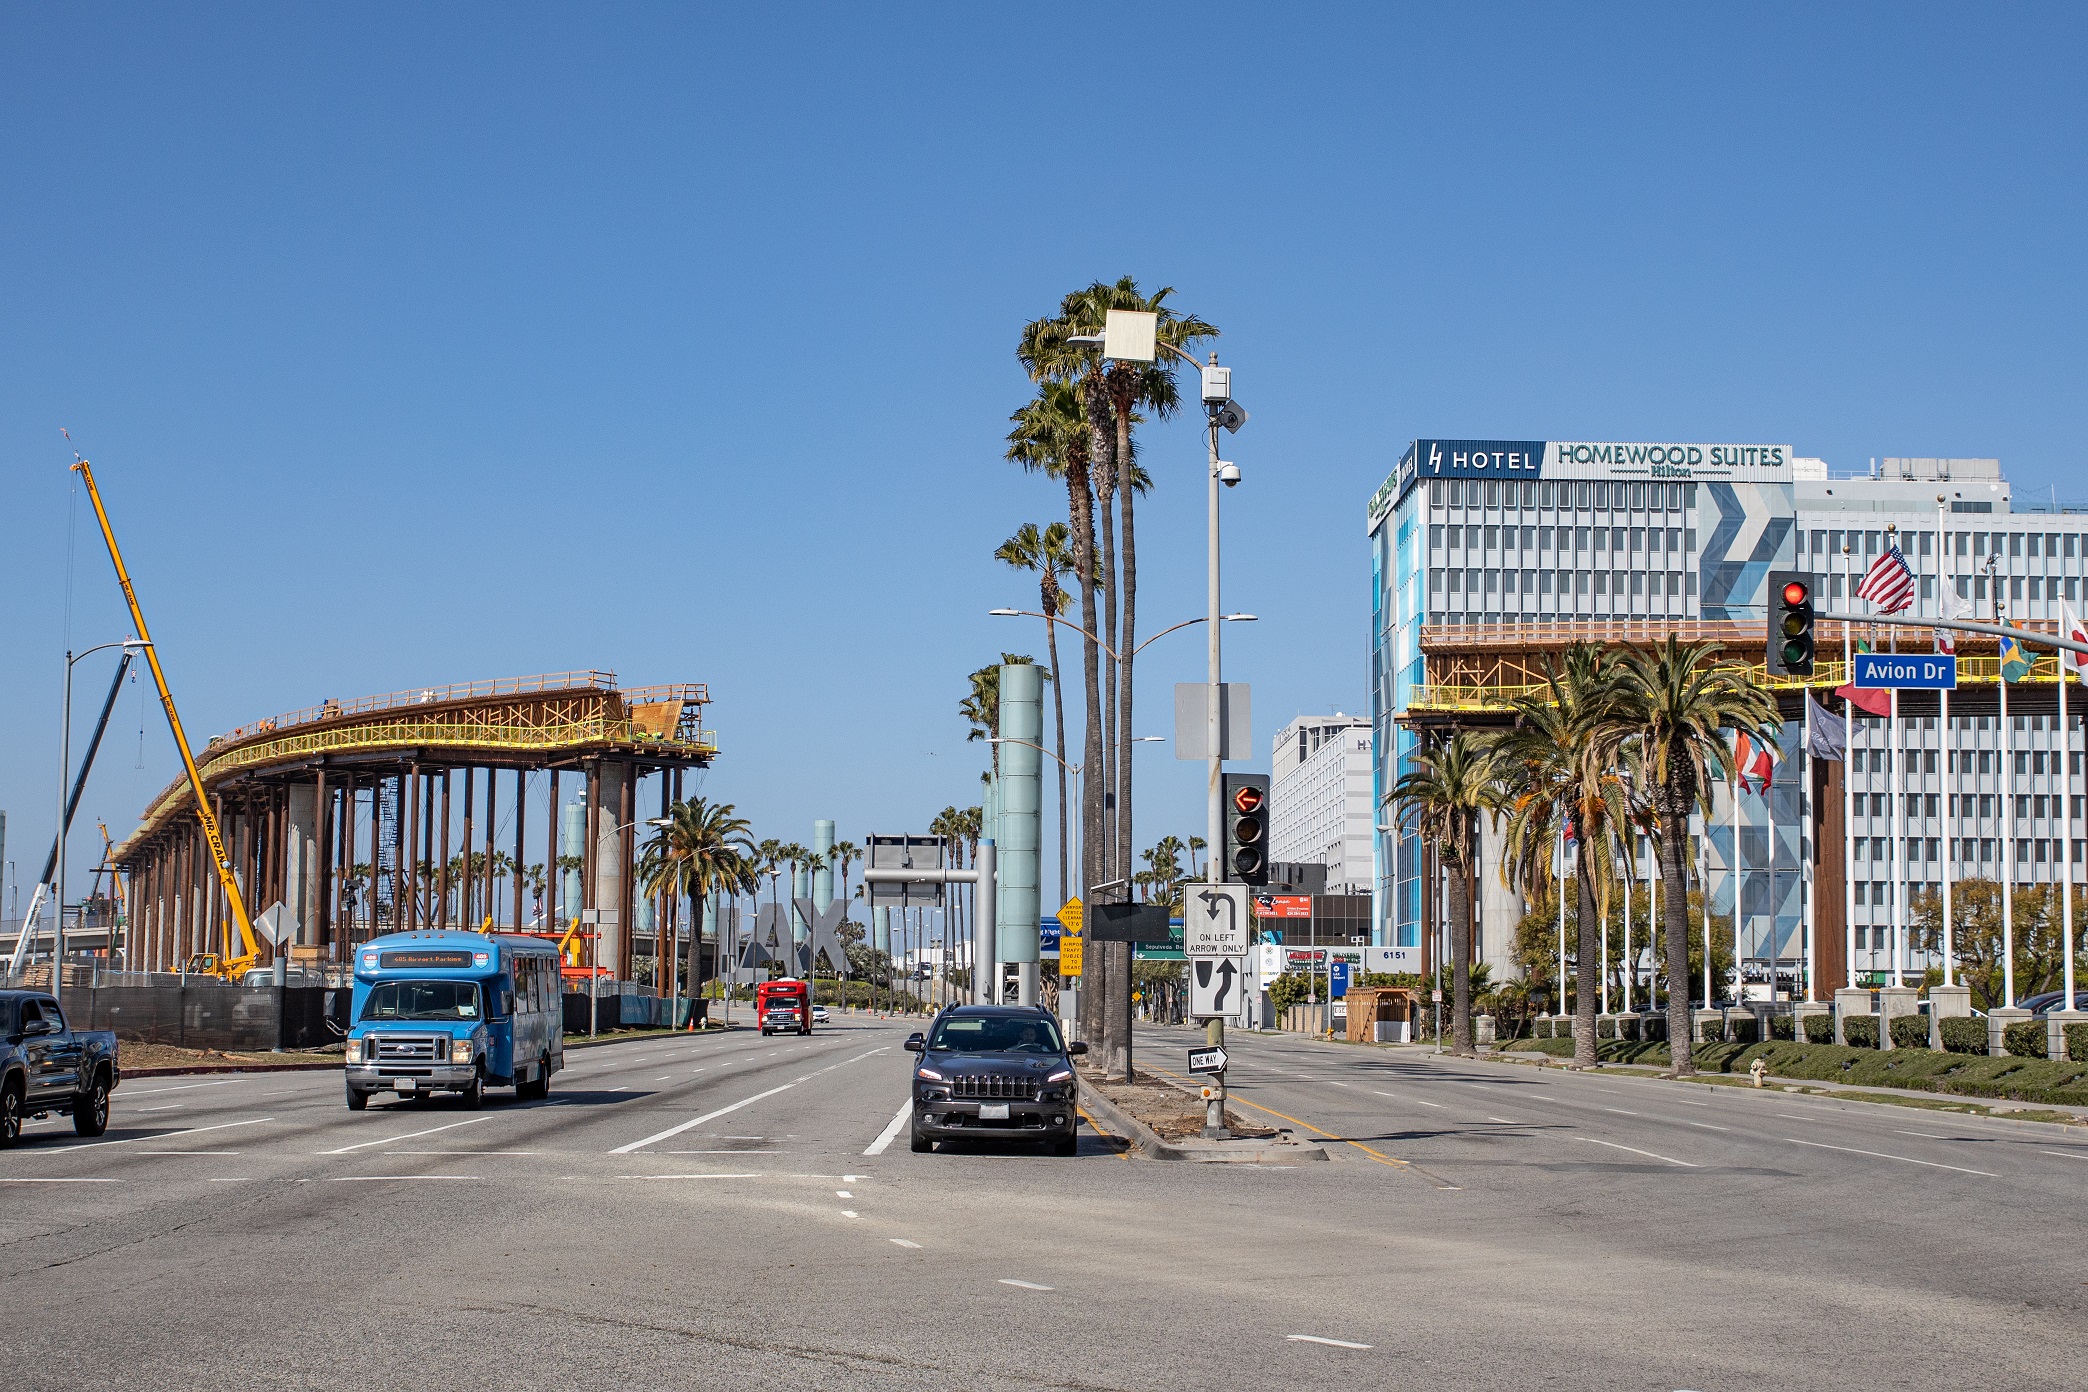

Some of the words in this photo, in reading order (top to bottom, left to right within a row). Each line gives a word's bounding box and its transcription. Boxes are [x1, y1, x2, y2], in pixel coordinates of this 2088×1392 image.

[1453, 451, 1536, 470] HOTEL
[1557, 445, 1703, 465] HOMEWOOD
[1710, 447, 1784, 467] SUITES
[1651, 465, 1692, 478] Hilton
[1865, 661, 1917, 680] Avion
[1924, 662, 1947, 680] Dr
[204, 814, 215, 834] MR.
[1258, 896, 1271, 904] For
[718, 898, 854, 984] LAX
[1200, 933, 1211, 941] ON
[1214, 933, 1235, 942] LEFT
[1190, 944, 1218, 952] ARROW
[1222, 944, 1244, 952] ONLY
[1383, 951, 1406, 959] 6151
[1192, 1056, 1204, 1067] ONE
[1204, 1054, 1217, 1066] WAY
